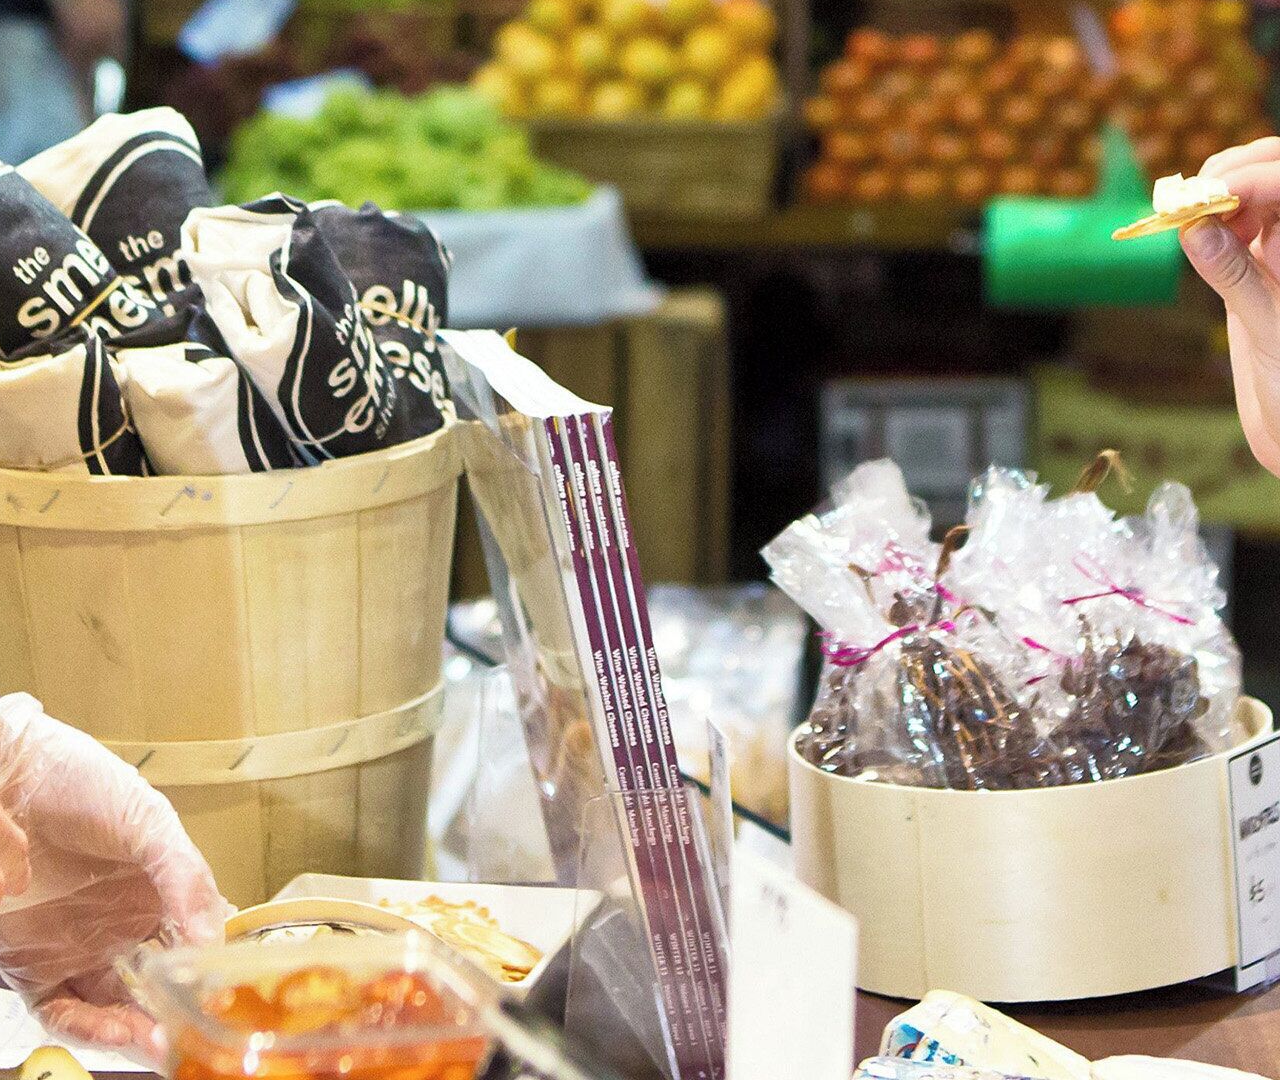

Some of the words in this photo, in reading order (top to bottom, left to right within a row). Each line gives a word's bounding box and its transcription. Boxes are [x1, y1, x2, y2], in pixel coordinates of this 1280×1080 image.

[13, 246, 50, 285] the
[120, 230, 164, 262] the
[18, 225, 111, 338] sme
[554, 464, 566, 498] culture
[574, 462, 586, 497] culture
[589, 460, 602, 494] culture
[610, 461, 621, 495] culture
[594, 650, 614, 711] Wine-Washed
[607, 712, 620, 747] Cheeses
[613, 649, 631, 710] Wine-Washed
[625, 711, 637, 746] Cheeses
[629, 646, 648, 707] Wine-Washed
[642, 708, 653, 743] Cheeses
[648, 647, 666, 708] Wine-Washed
[659, 710, 671, 745] Cheeses
